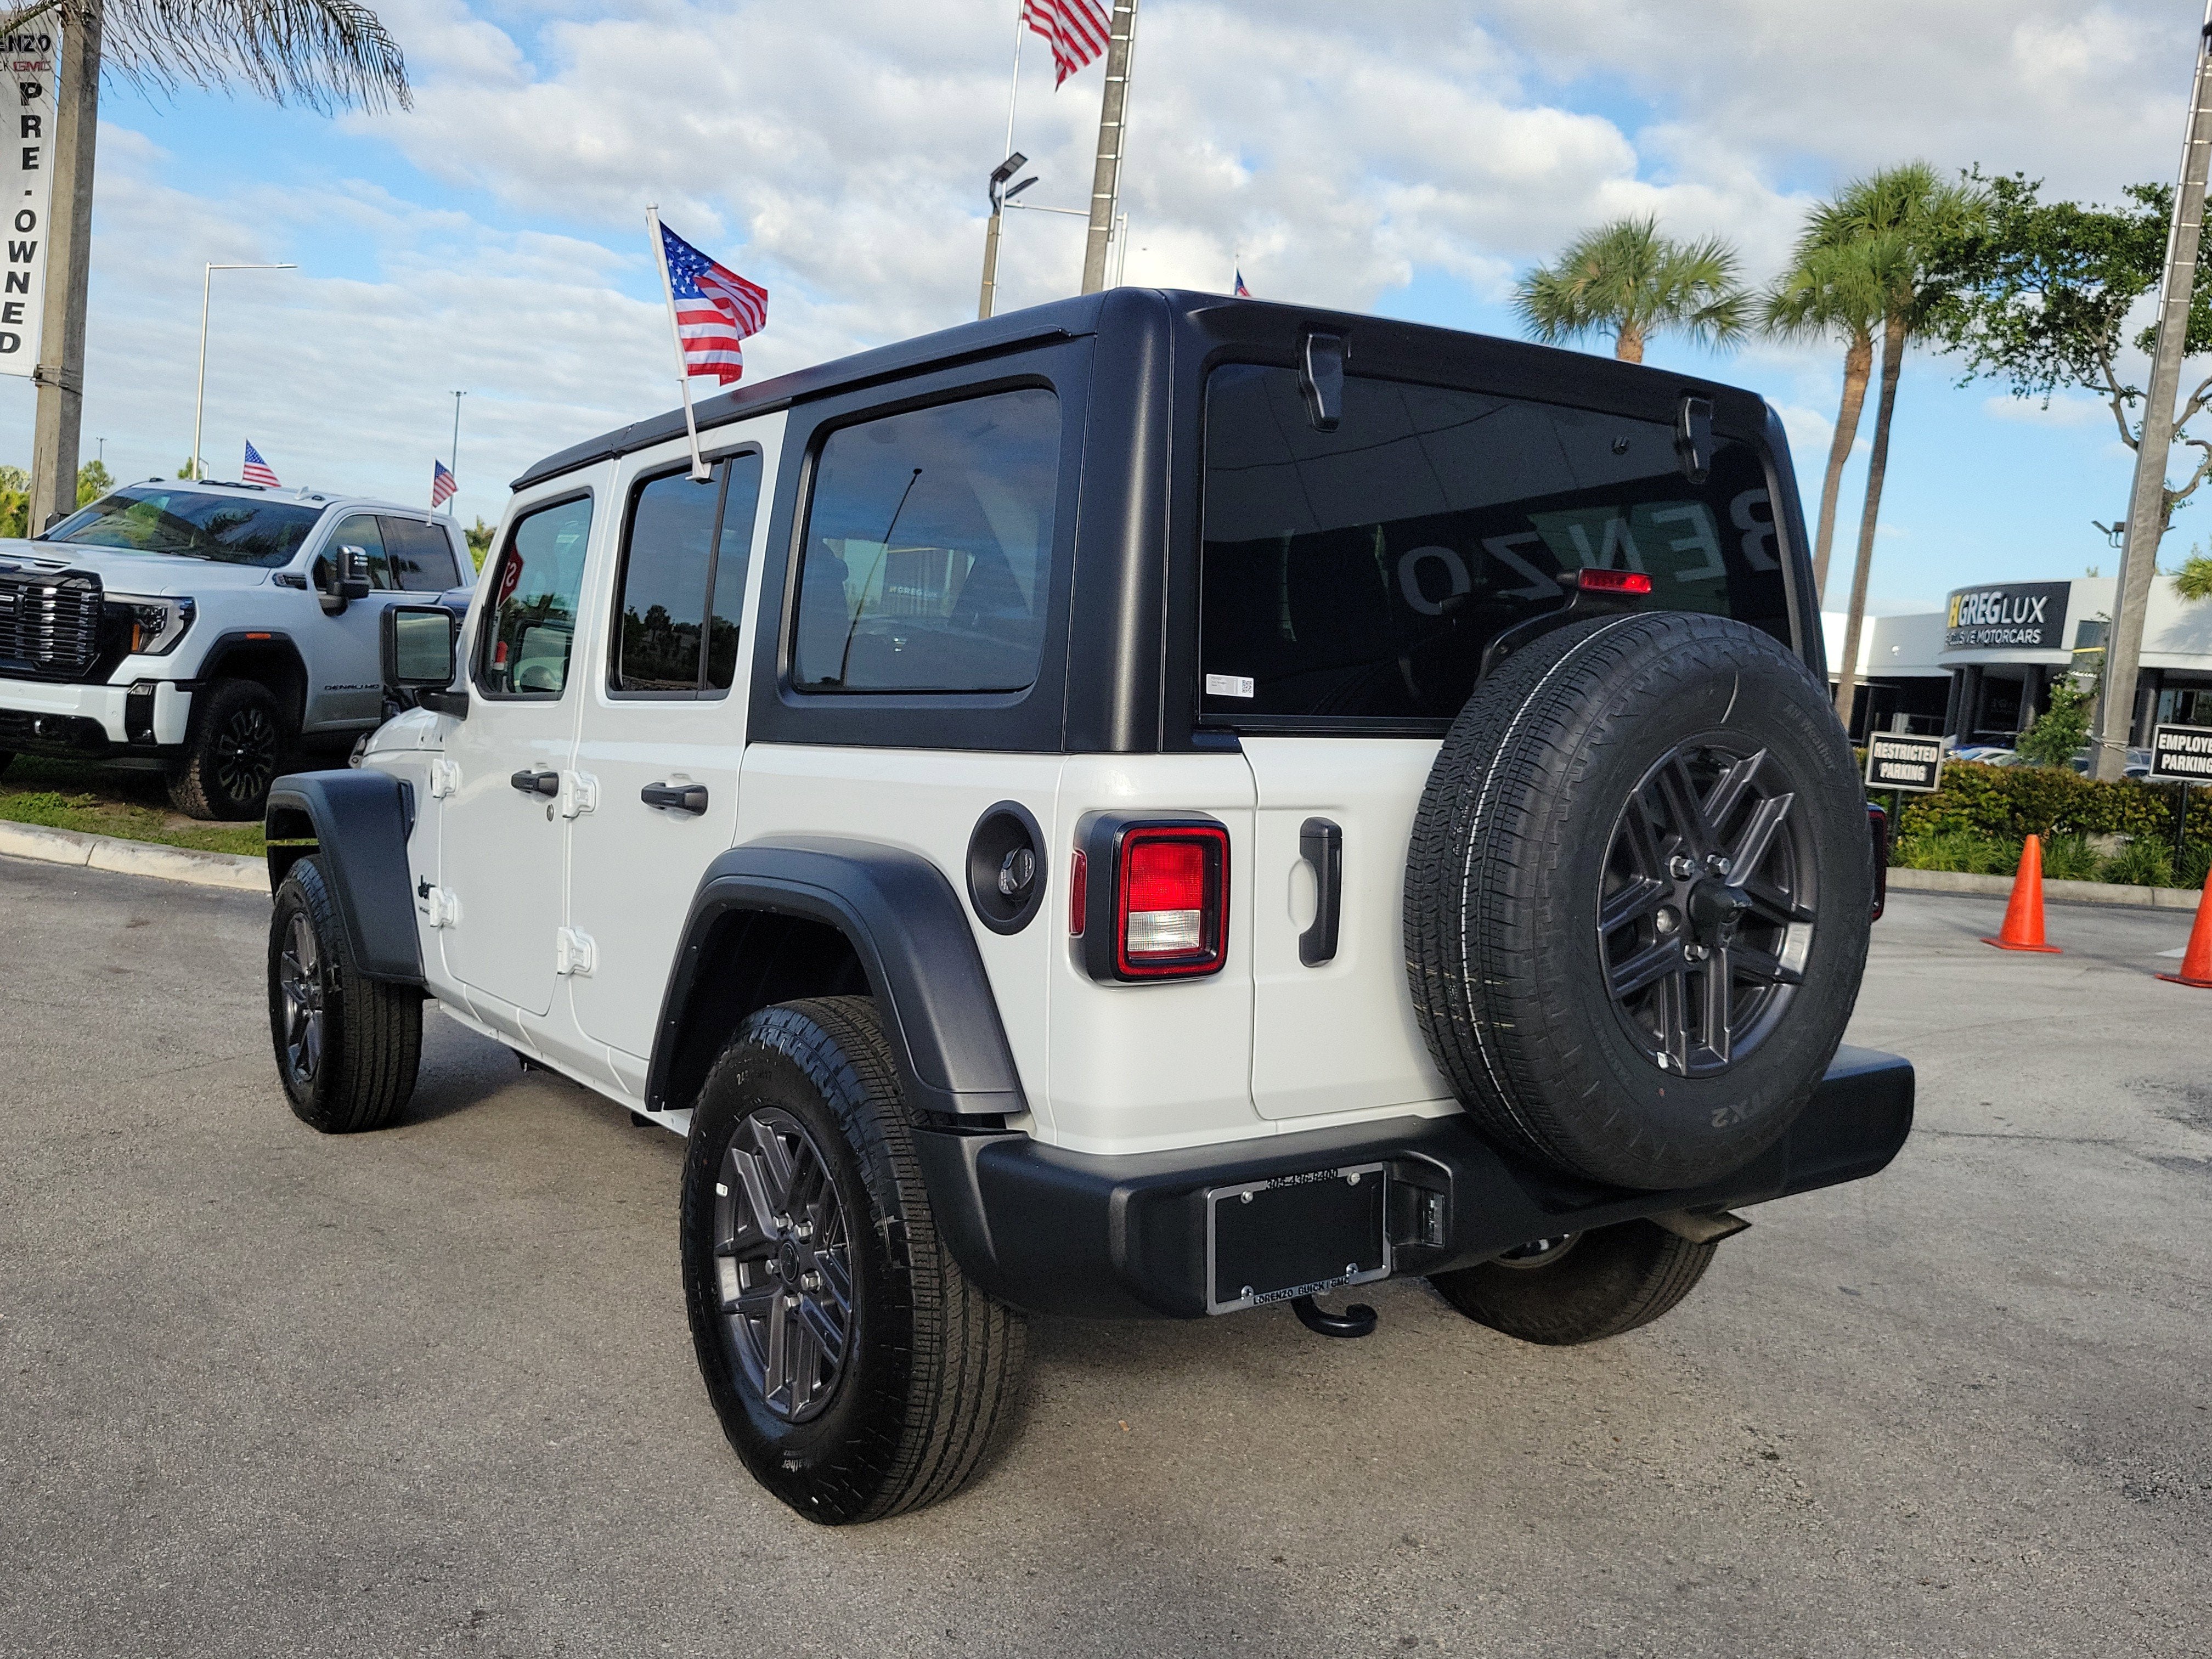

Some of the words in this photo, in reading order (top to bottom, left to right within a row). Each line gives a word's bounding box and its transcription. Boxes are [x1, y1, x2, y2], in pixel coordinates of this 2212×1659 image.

[13, 60, 52, 72] GMC
[1976, 628, 2042, 645] MOTORCARS
[1874, 742, 1938, 763] RESTRICTED
[1880, 761, 1927, 782] PARKING
[2161, 753, 2212, 774] PARKING
[1253, 1289, 1294, 1305] LORENZO
[1298, 1282, 1325, 1295] BUICK
[1330, 1276, 1350, 1288] GMC
